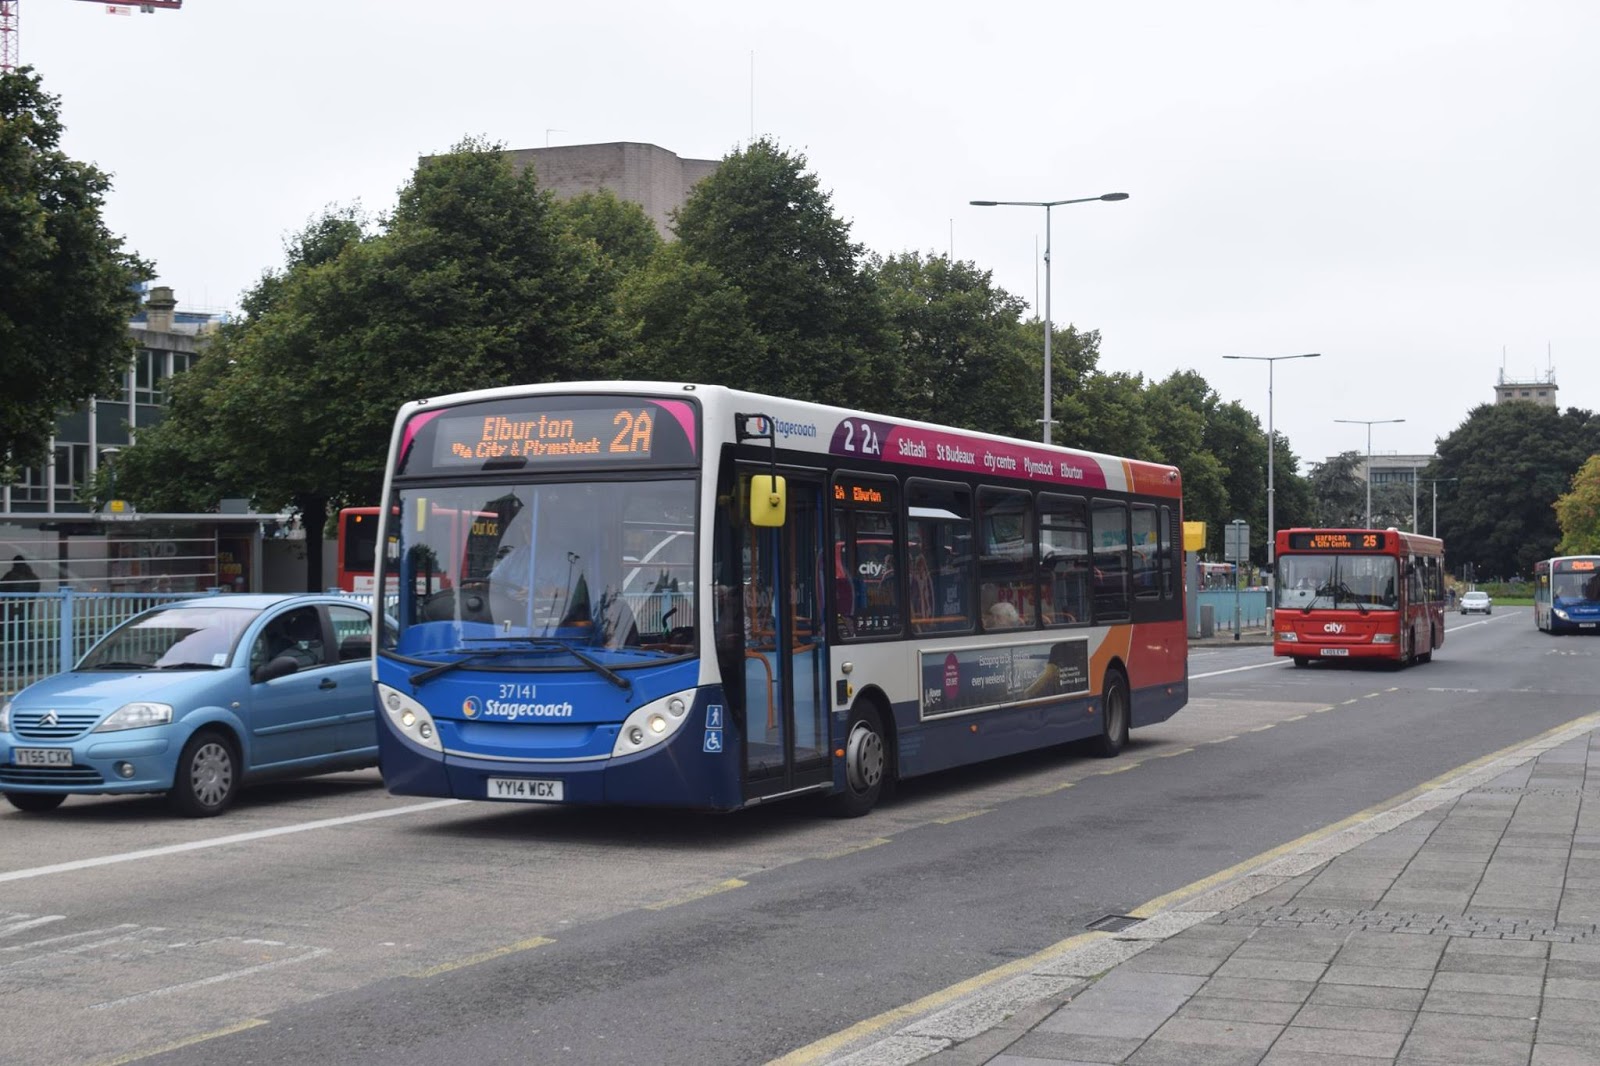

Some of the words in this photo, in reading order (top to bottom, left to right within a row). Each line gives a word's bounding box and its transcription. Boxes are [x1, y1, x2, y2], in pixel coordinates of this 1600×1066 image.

[482, 415, 574, 441] Elburton
[609, 410, 652, 453] 2A
[771, 416, 817, 438] tagecoach
[476, 441, 508, 458] City
[843, 420, 855, 452] 2
[861, 423, 880, 455] 2A
[898, 438, 927, 458] Saltash
[936, 443, 945, 461] St
[945, 445, 975, 465] Budeaux
[983, 450, 996, 472] city
[996, 455, 1016, 470] centre
[1023, 456, 1053, 477] Plymstock
[1060, 462, 1083, 479] Elburton
[1363, 534, 1377, 547] 25
[858, 561, 882, 577] city
[1323, 622, 1343, 634] city
[499, 683, 536, 699] 37141
[484, 699, 573, 720] Stagecoach
[47, 750, 71, 764] CXK
[496, 780, 525, 796] YY14
[528, 781, 555, 797] WGX
